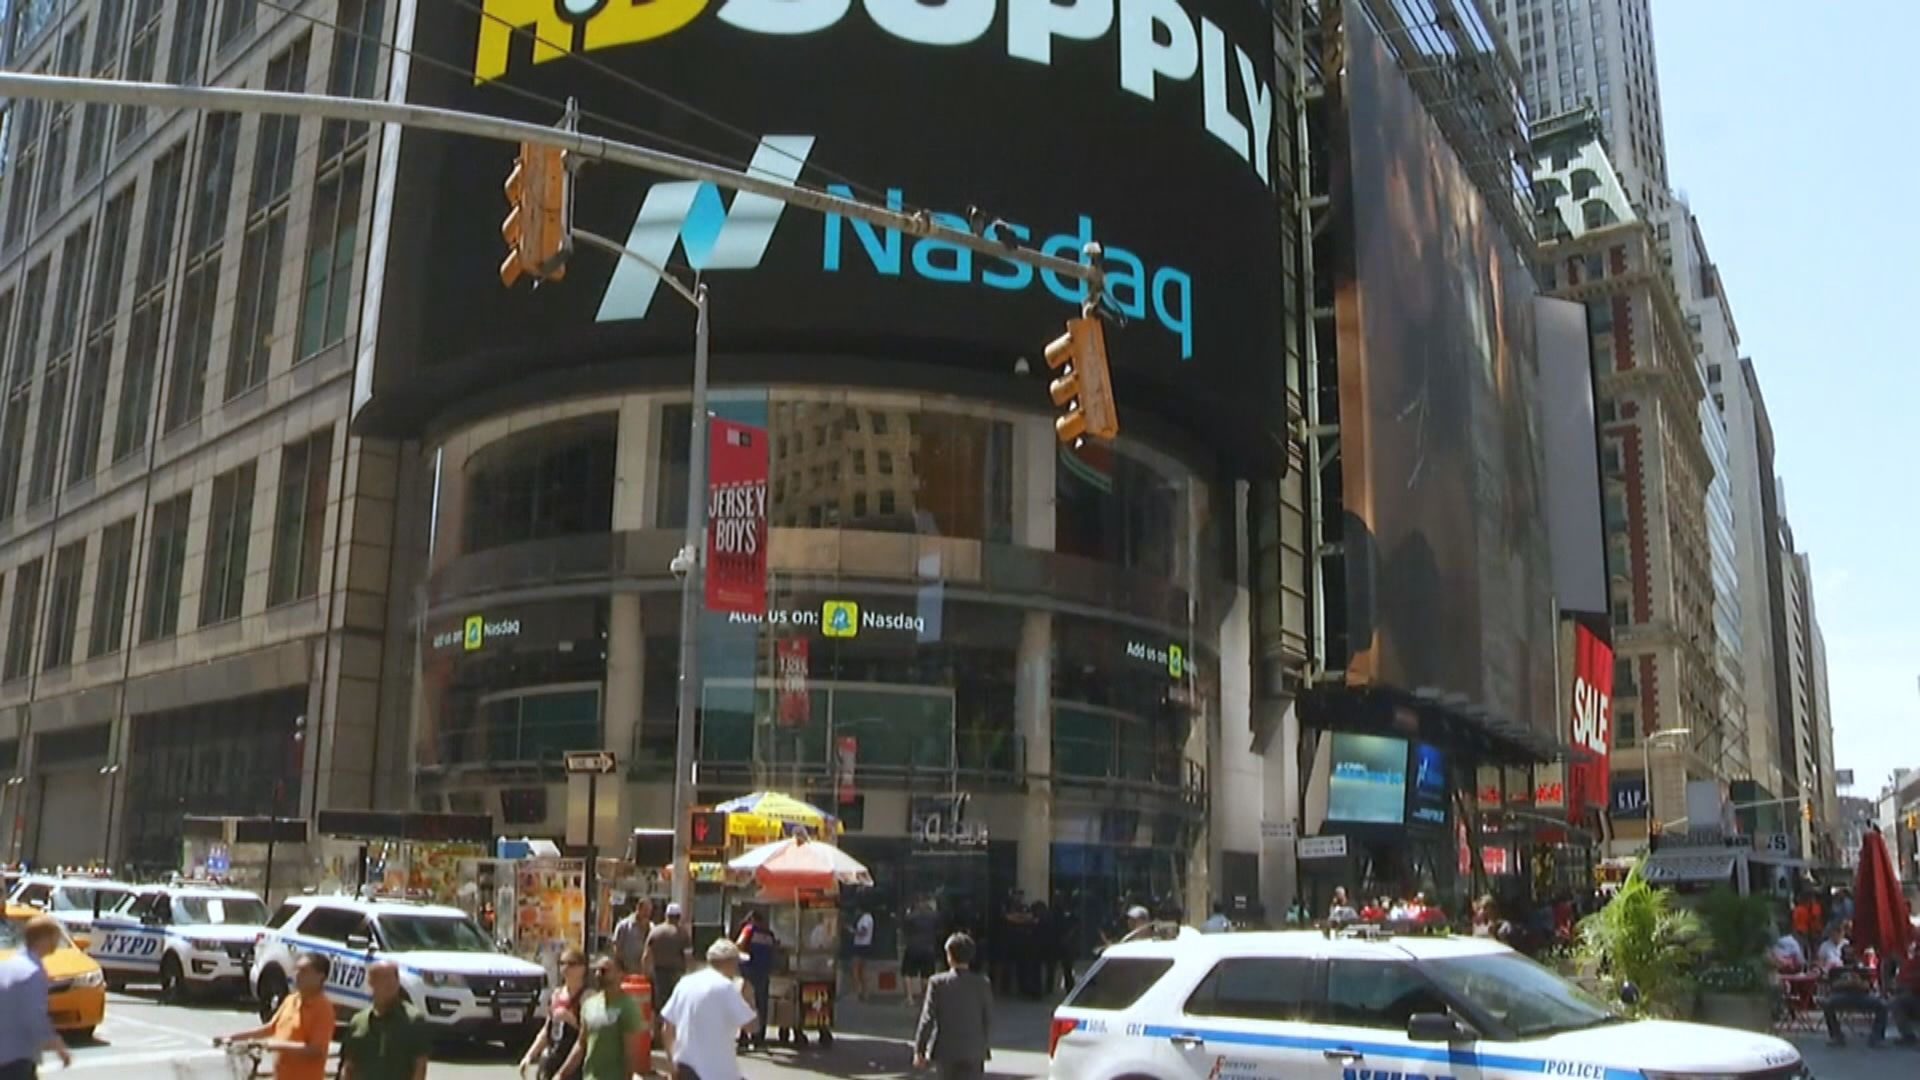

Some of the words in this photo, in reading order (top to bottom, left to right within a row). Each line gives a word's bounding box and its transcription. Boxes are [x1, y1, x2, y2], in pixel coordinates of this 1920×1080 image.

[824, 184, 1192, 359] Nasdaq
[709, 486, 766, 518] JERSEY
[715, 519, 756, 554] BOYS
[484, 619, 520, 636] Nasdaq
[768, 610, 788, 624] us
[792, 610, 819, 624] on:
[862, 611, 925, 633] Nasdaq
[1127, 641, 1145, 659] Add
[1147, 647, 1156, 661] us
[1573, 676, 1608, 755] SALE
[1618, 790, 1641, 809] GAP
[100, 934, 157, 956] NYPD
[330, 953, 366, 988] NYPD
[1547, 1060, 1602, 1079] POLICE
